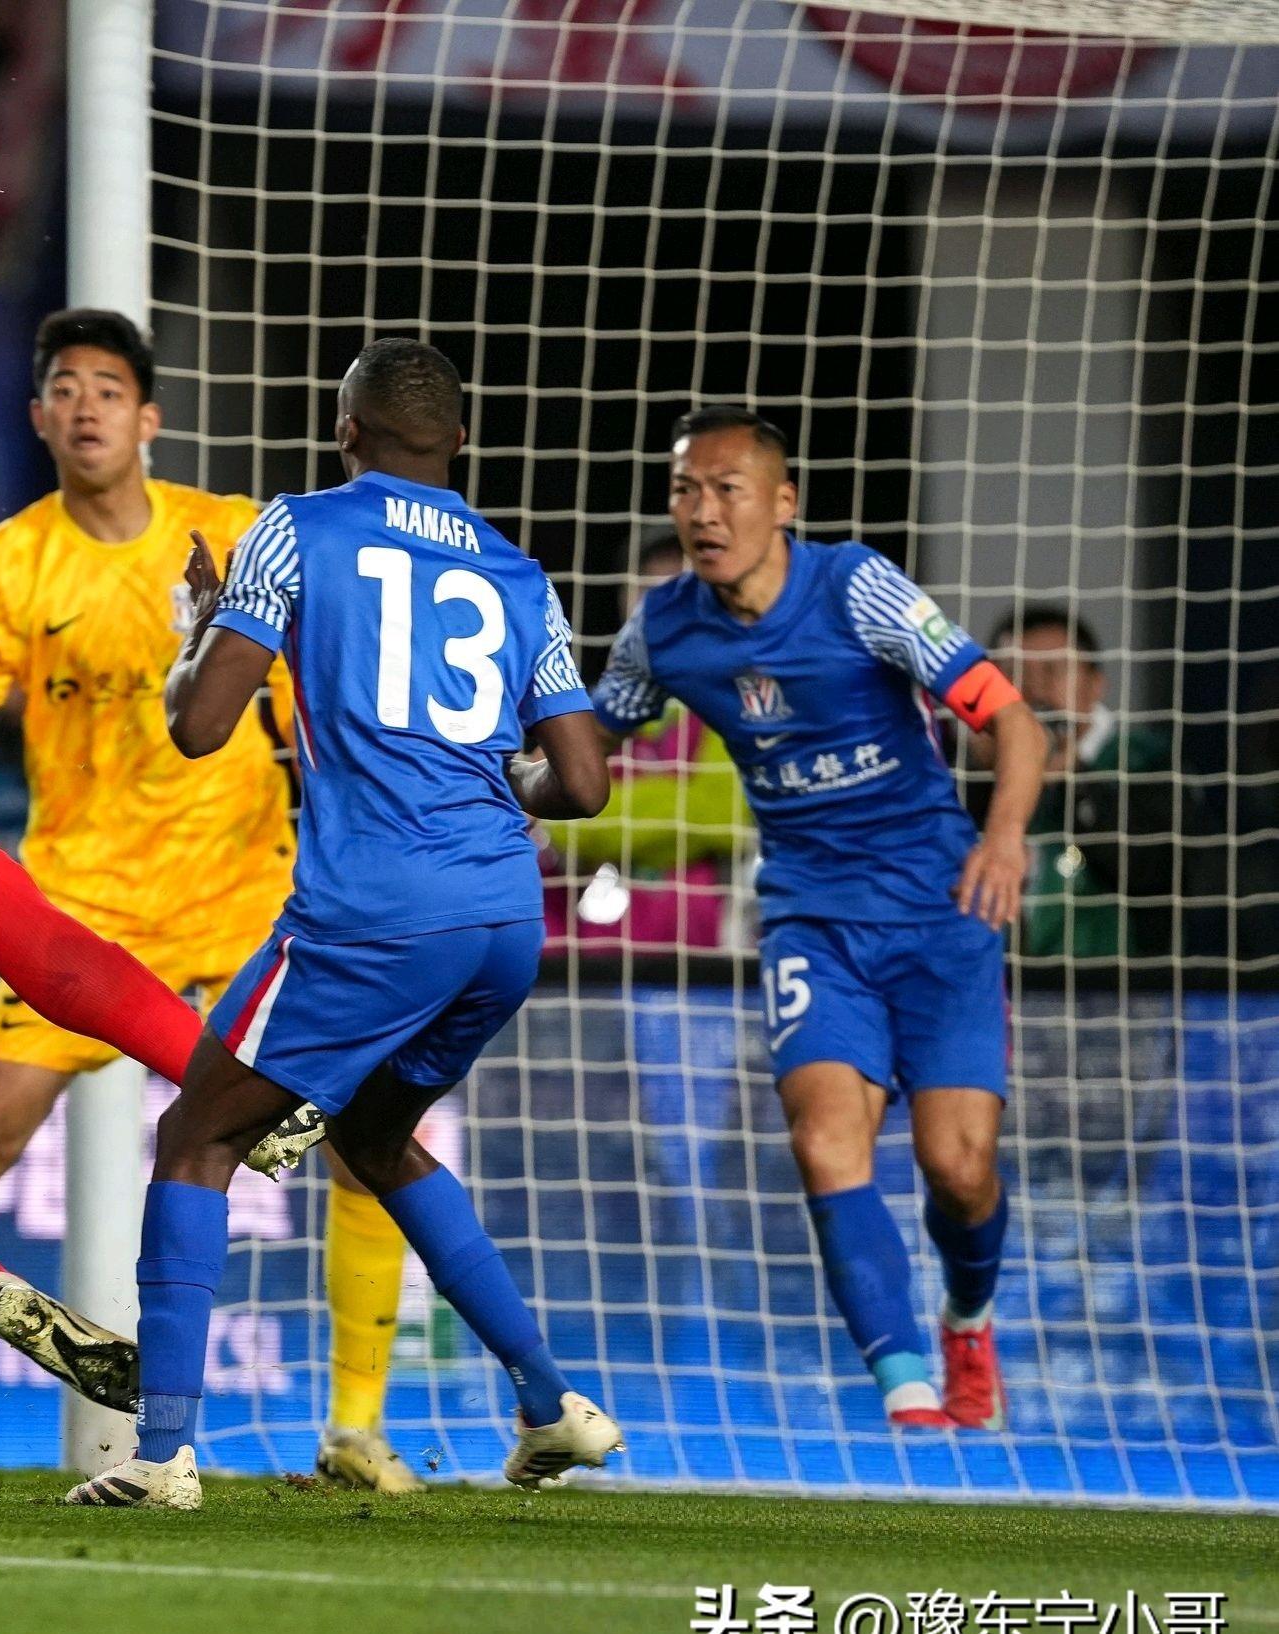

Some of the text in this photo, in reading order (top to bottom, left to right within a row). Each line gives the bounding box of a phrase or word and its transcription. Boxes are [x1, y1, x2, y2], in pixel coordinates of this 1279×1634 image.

[385, 497, 481, 554] MANAFA
[357, 546, 506, 744] 13
[763, 956, 812, 1028] 15
